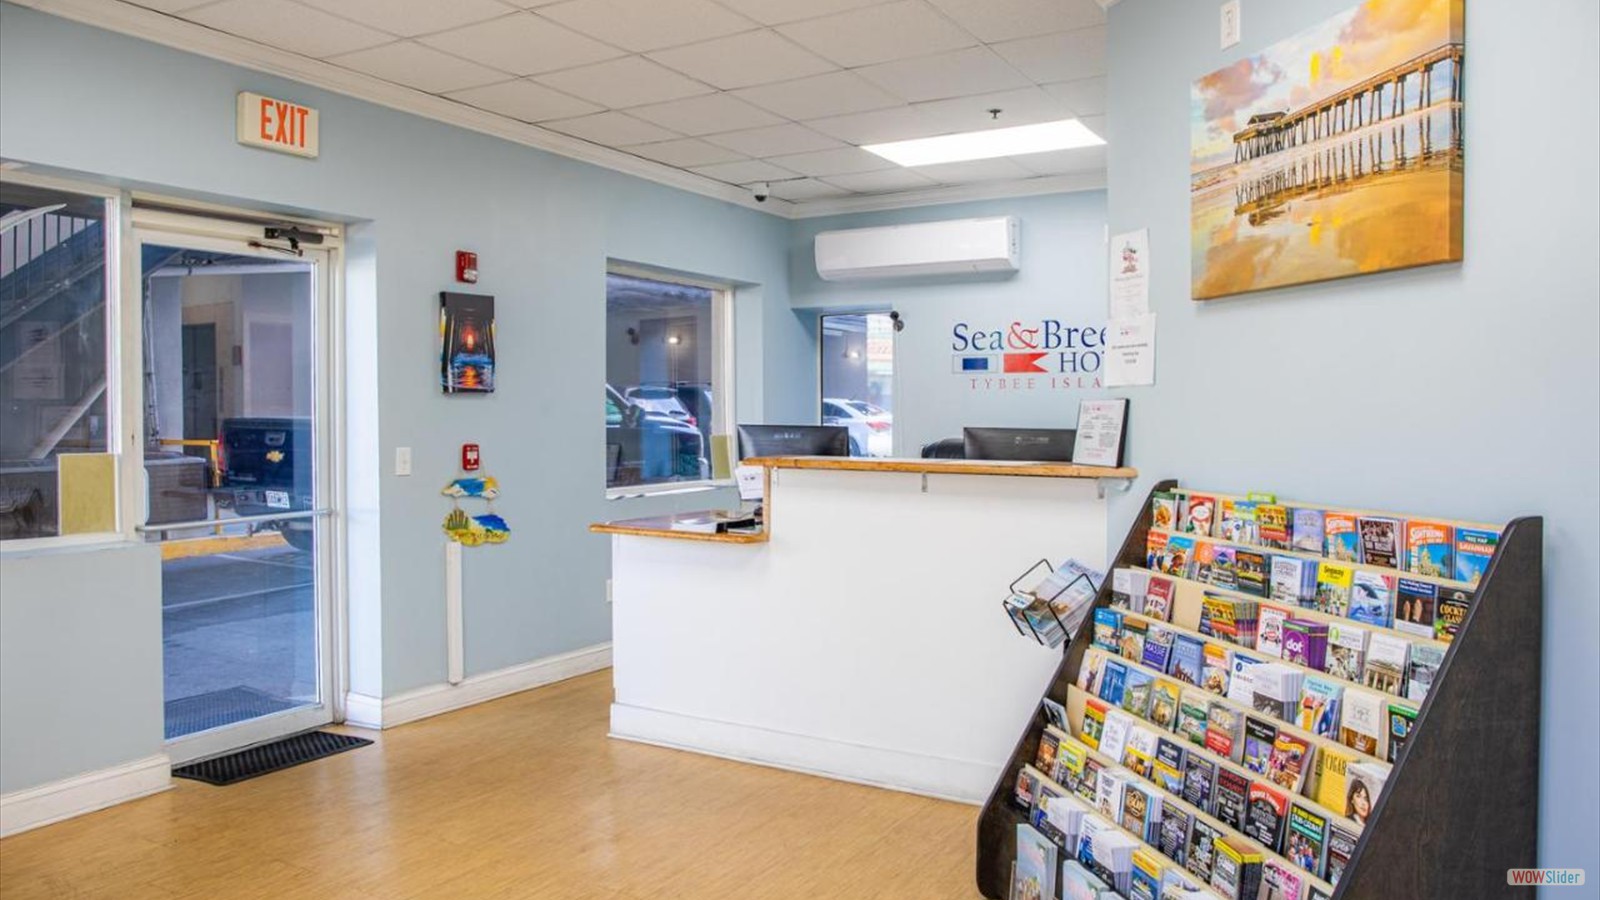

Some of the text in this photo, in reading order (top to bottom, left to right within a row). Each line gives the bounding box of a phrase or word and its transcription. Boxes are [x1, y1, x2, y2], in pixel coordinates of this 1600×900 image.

[260, 98, 309, 148] EXIT
[1059, 351, 1106, 373] HO
[970, 377, 1036, 390] TYBEE
[1286, 639, 1304, 653] dot
[1325, 753, 1347, 776] CIGAR
